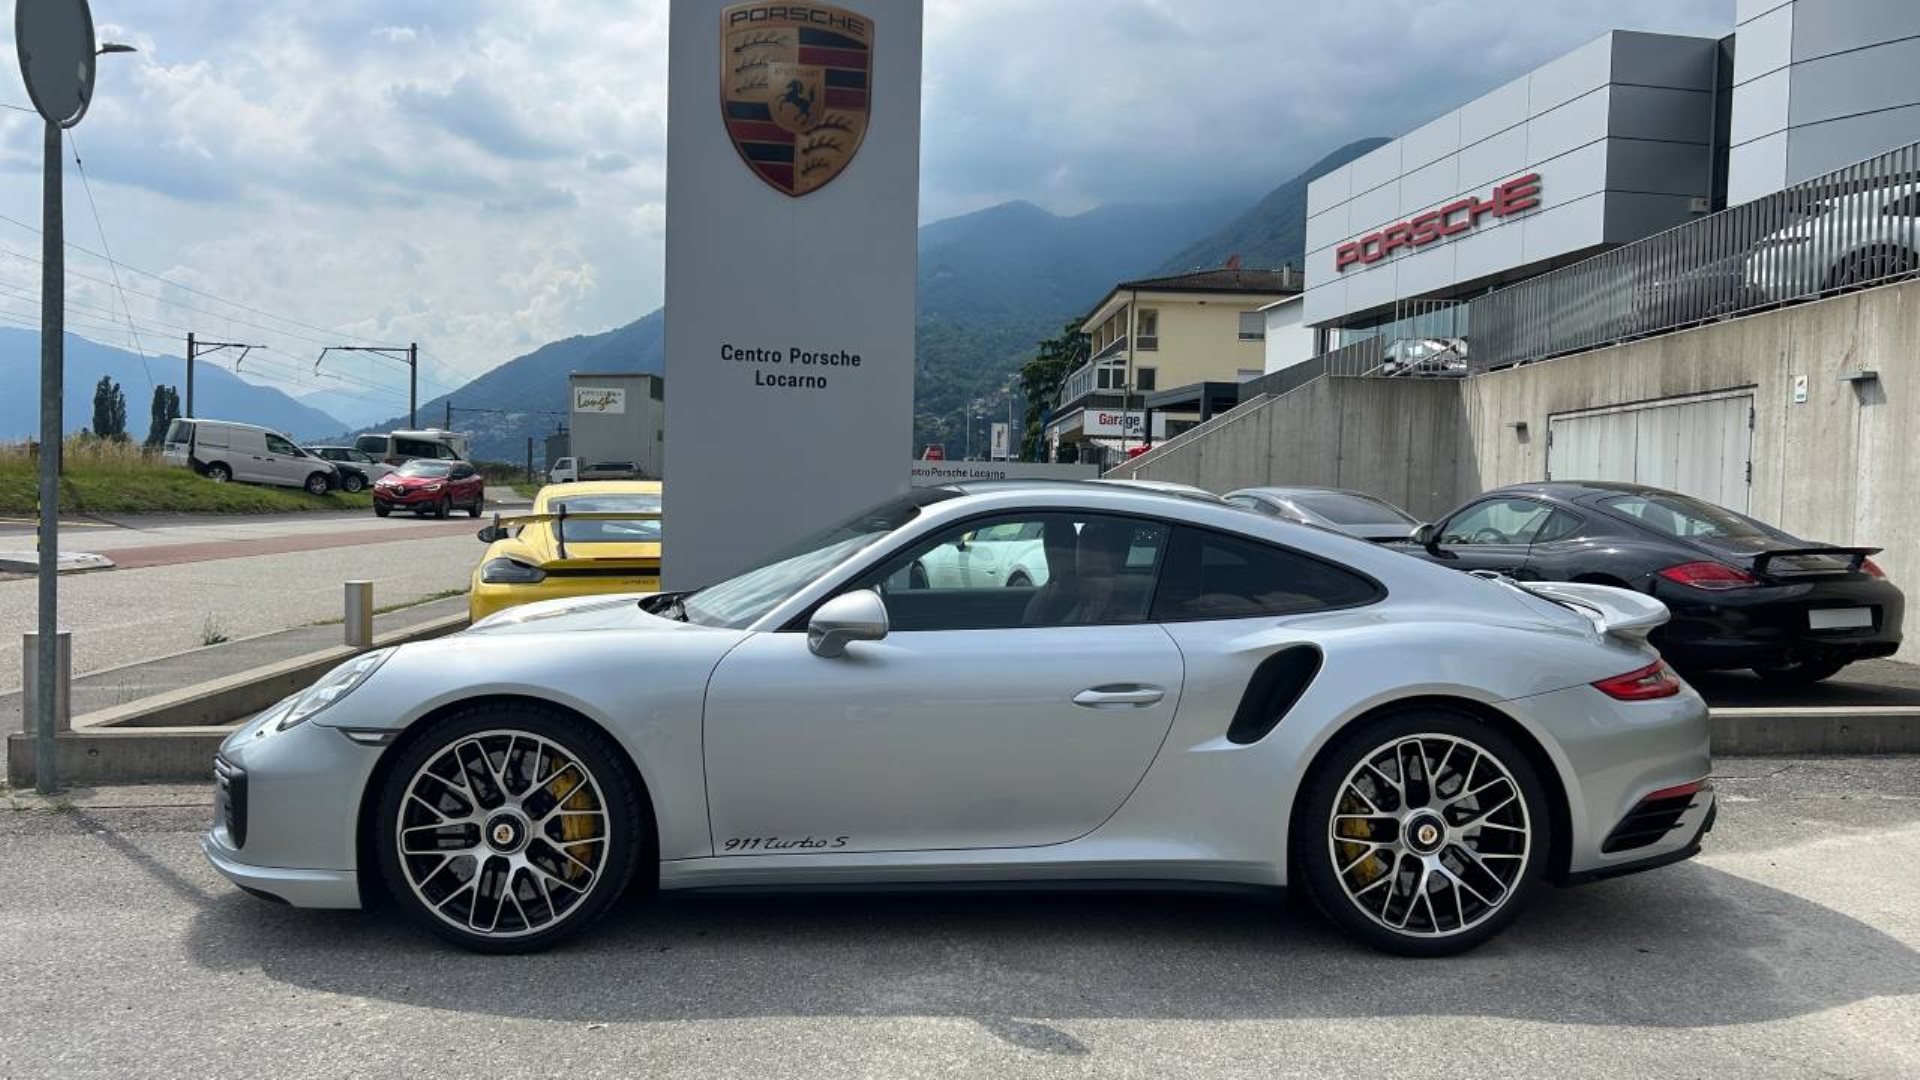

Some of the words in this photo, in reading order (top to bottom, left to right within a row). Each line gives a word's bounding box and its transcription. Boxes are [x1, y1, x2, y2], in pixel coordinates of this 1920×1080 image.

[730, 6, 865, 37] PORSCHE
[1336, 173, 1541, 272] PORSCHE
[720, 344, 782, 363] Centro
[789, 347, 862, 367] Porsche
[755, 369, 828, 389] Locarno
[1098, 413, 1141, 429] Garage
[931, 467, 968, 477] Porsche
[970, 468, 1006, 479] Locarno
[724, 838, 761, 851] 911
[830, 836, 850, 848] S
